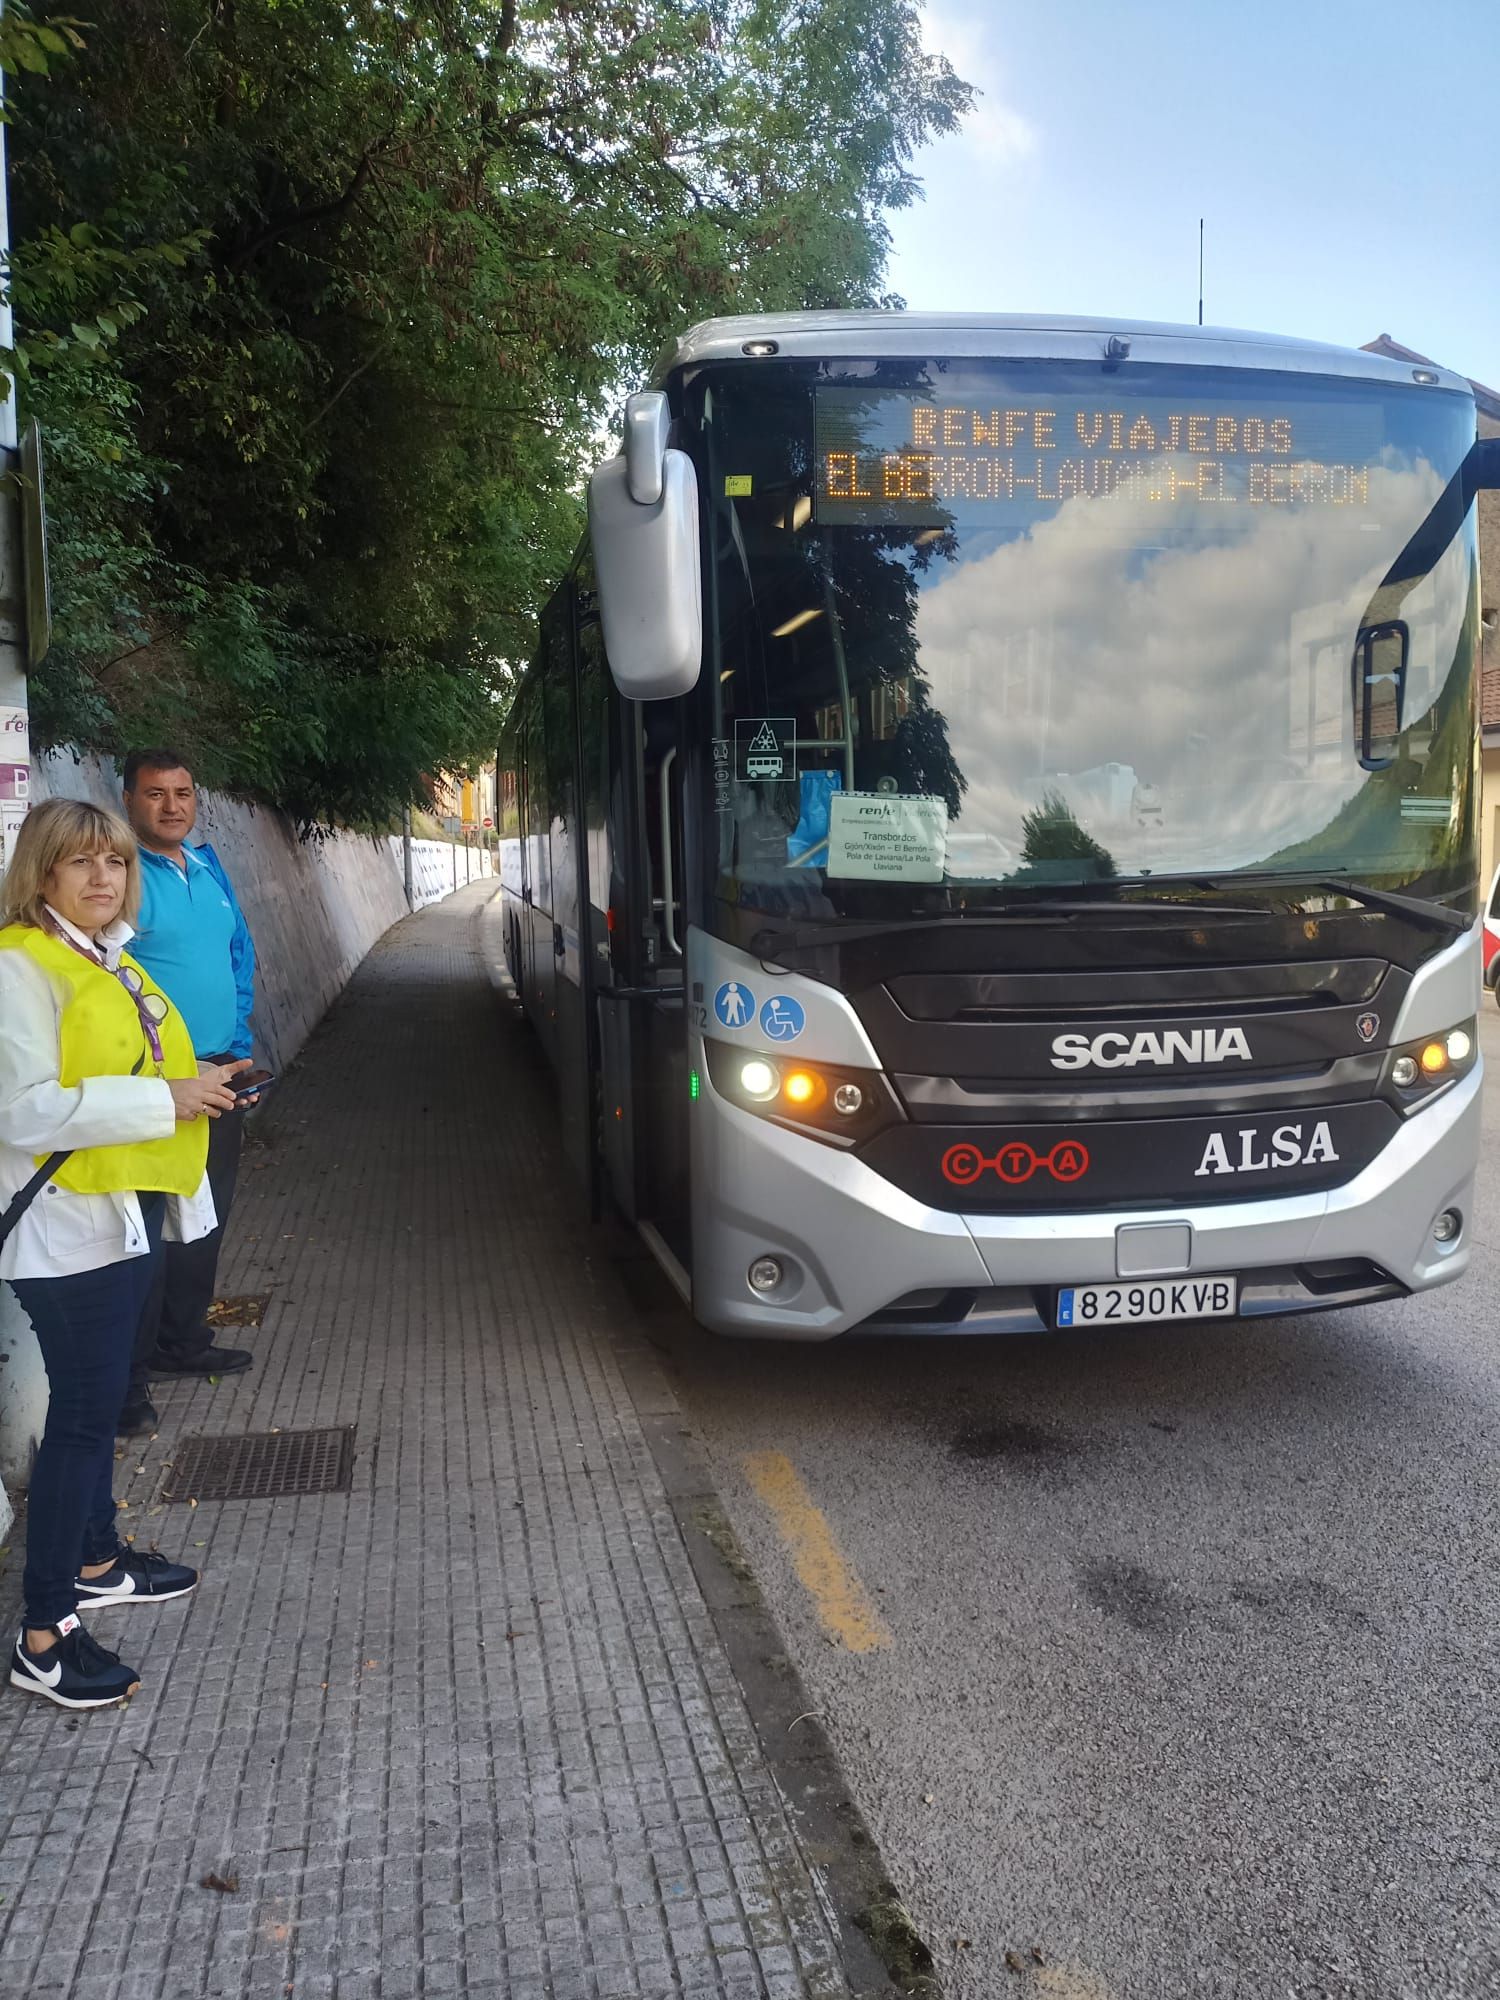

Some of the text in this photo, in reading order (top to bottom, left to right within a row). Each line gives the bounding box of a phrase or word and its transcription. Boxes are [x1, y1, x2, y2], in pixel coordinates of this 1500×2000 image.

[913, 407, 1293, 454] RENFE VIAJEROS
[826, 453, 871, 497] EL
[1249, 462, 1368, 504] BERRON
[859, 804, 896, 819] renfe
[863, 831, 917, 842] Transbordos
[846, 852, 862, 860] Pola
[915, 854, 931, 862] Pola
[873, 862, 903, 871] Llaviana
[1050, 1027, 1253, 1070] SCANIA
[1194, 1121, 1340, 1176] ALSA
